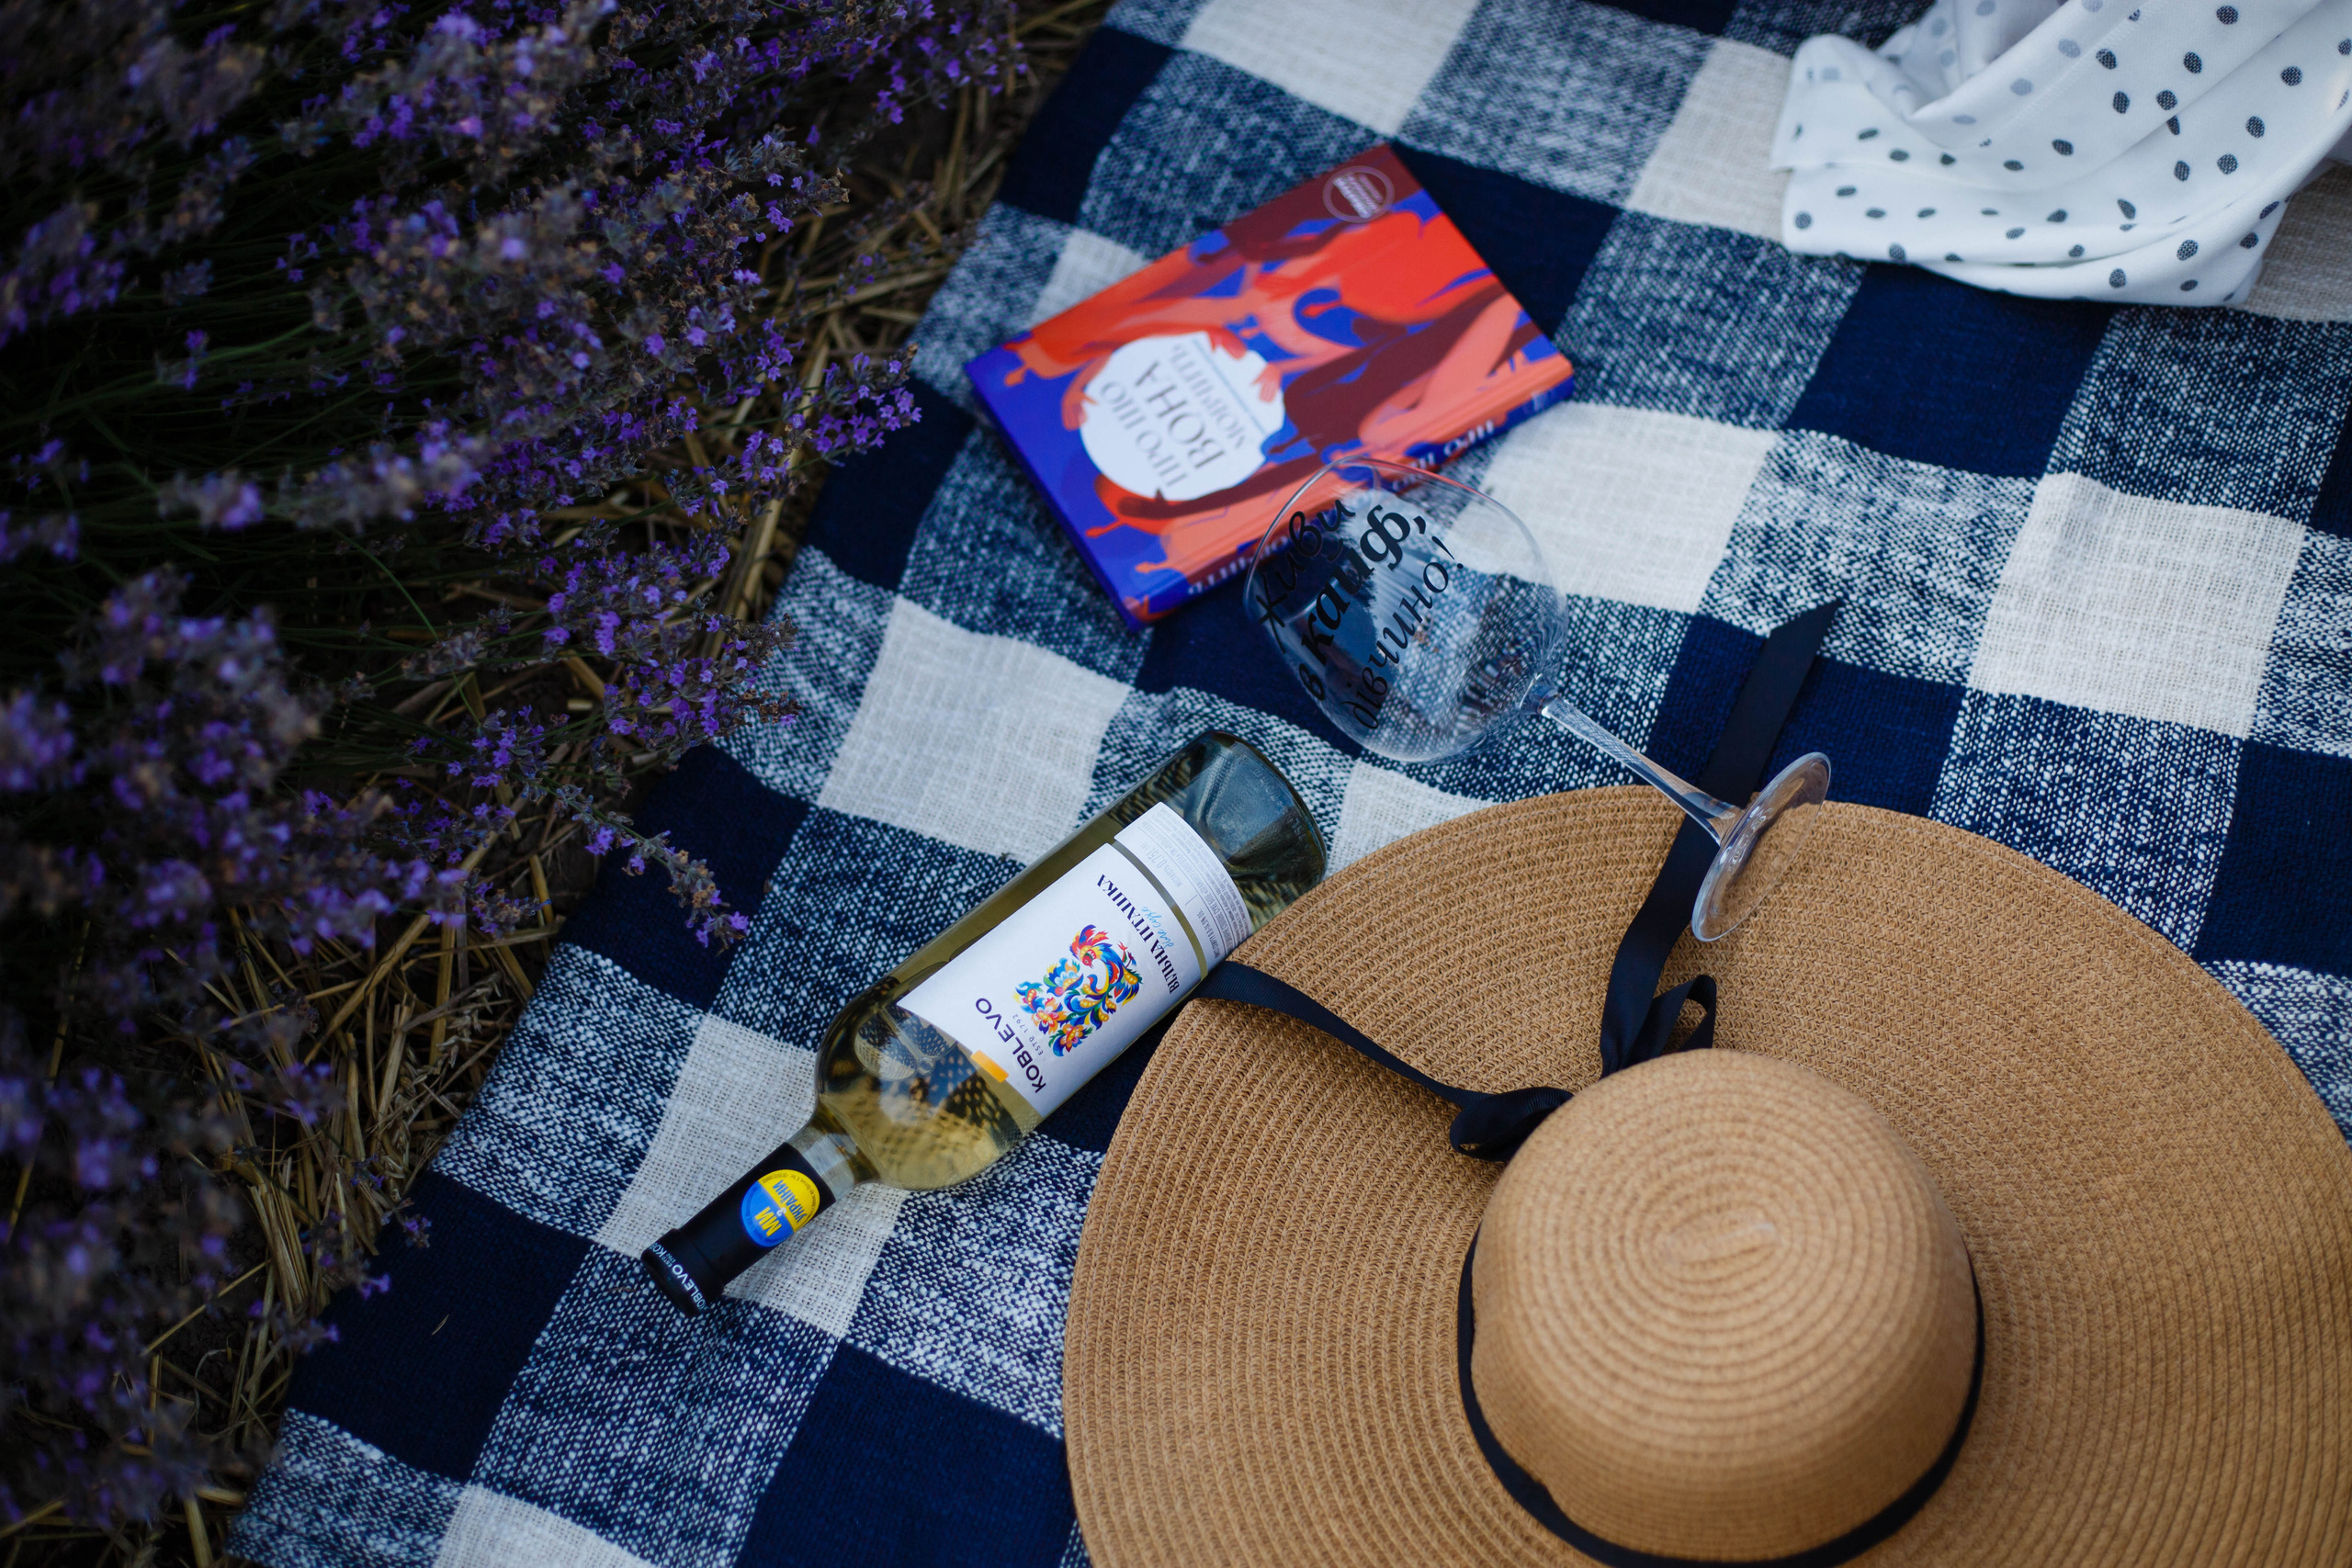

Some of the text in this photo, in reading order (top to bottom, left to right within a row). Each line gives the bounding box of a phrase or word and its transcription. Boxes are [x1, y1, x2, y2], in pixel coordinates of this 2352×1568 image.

[1135, 361, 1225, 468] ВОНА
[1256, 500, 1355, 654] Живи
[1301, 504, 1426, 666] кайф,
[1340, 536, 1464, 729] дівчино!
[1298, 663, 1325, 701] в
[1097, 874, 1180, 994] ВІЛЬНА ПТАШКА
[1141, 906, 1174, 948] біле сухе
[976, 998, 1046, 1093] KOBLEVO
[1012, 1014, 1028, 1032] 1792
[754, 1206, 782, 1237] МИ
[773, 1179, 808, 1223] УКРАЇНИ
